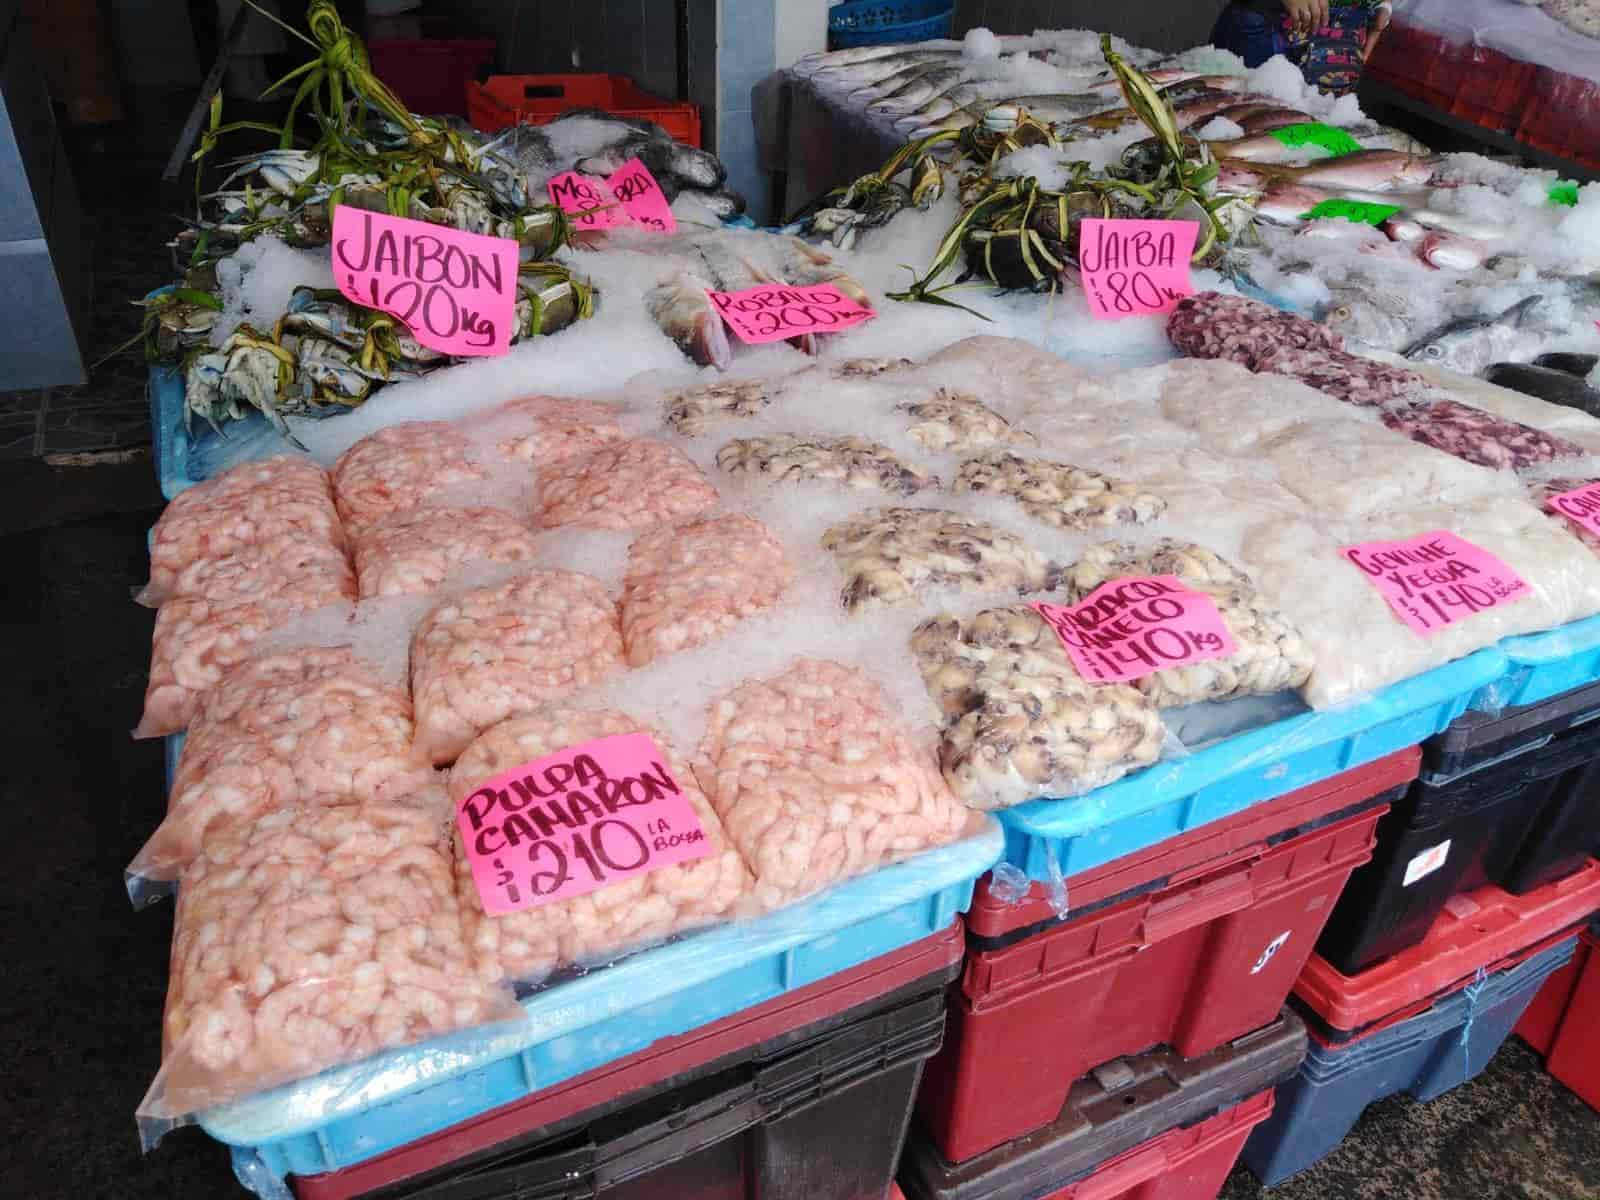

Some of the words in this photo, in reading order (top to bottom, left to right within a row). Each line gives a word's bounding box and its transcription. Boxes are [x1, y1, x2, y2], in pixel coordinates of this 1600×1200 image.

[336, 214, 503, 294] JAIBON
[1082, 224, 1175, 272] JAIBA
[1386, 560, 1480, 598] YEGUA
[1057, 598, 1184, 649] CANELO
[462, 754, 607, 831] PULPA
[475, 761, 679, 855] CAMARON
[648, 818, 671, 835] LA
